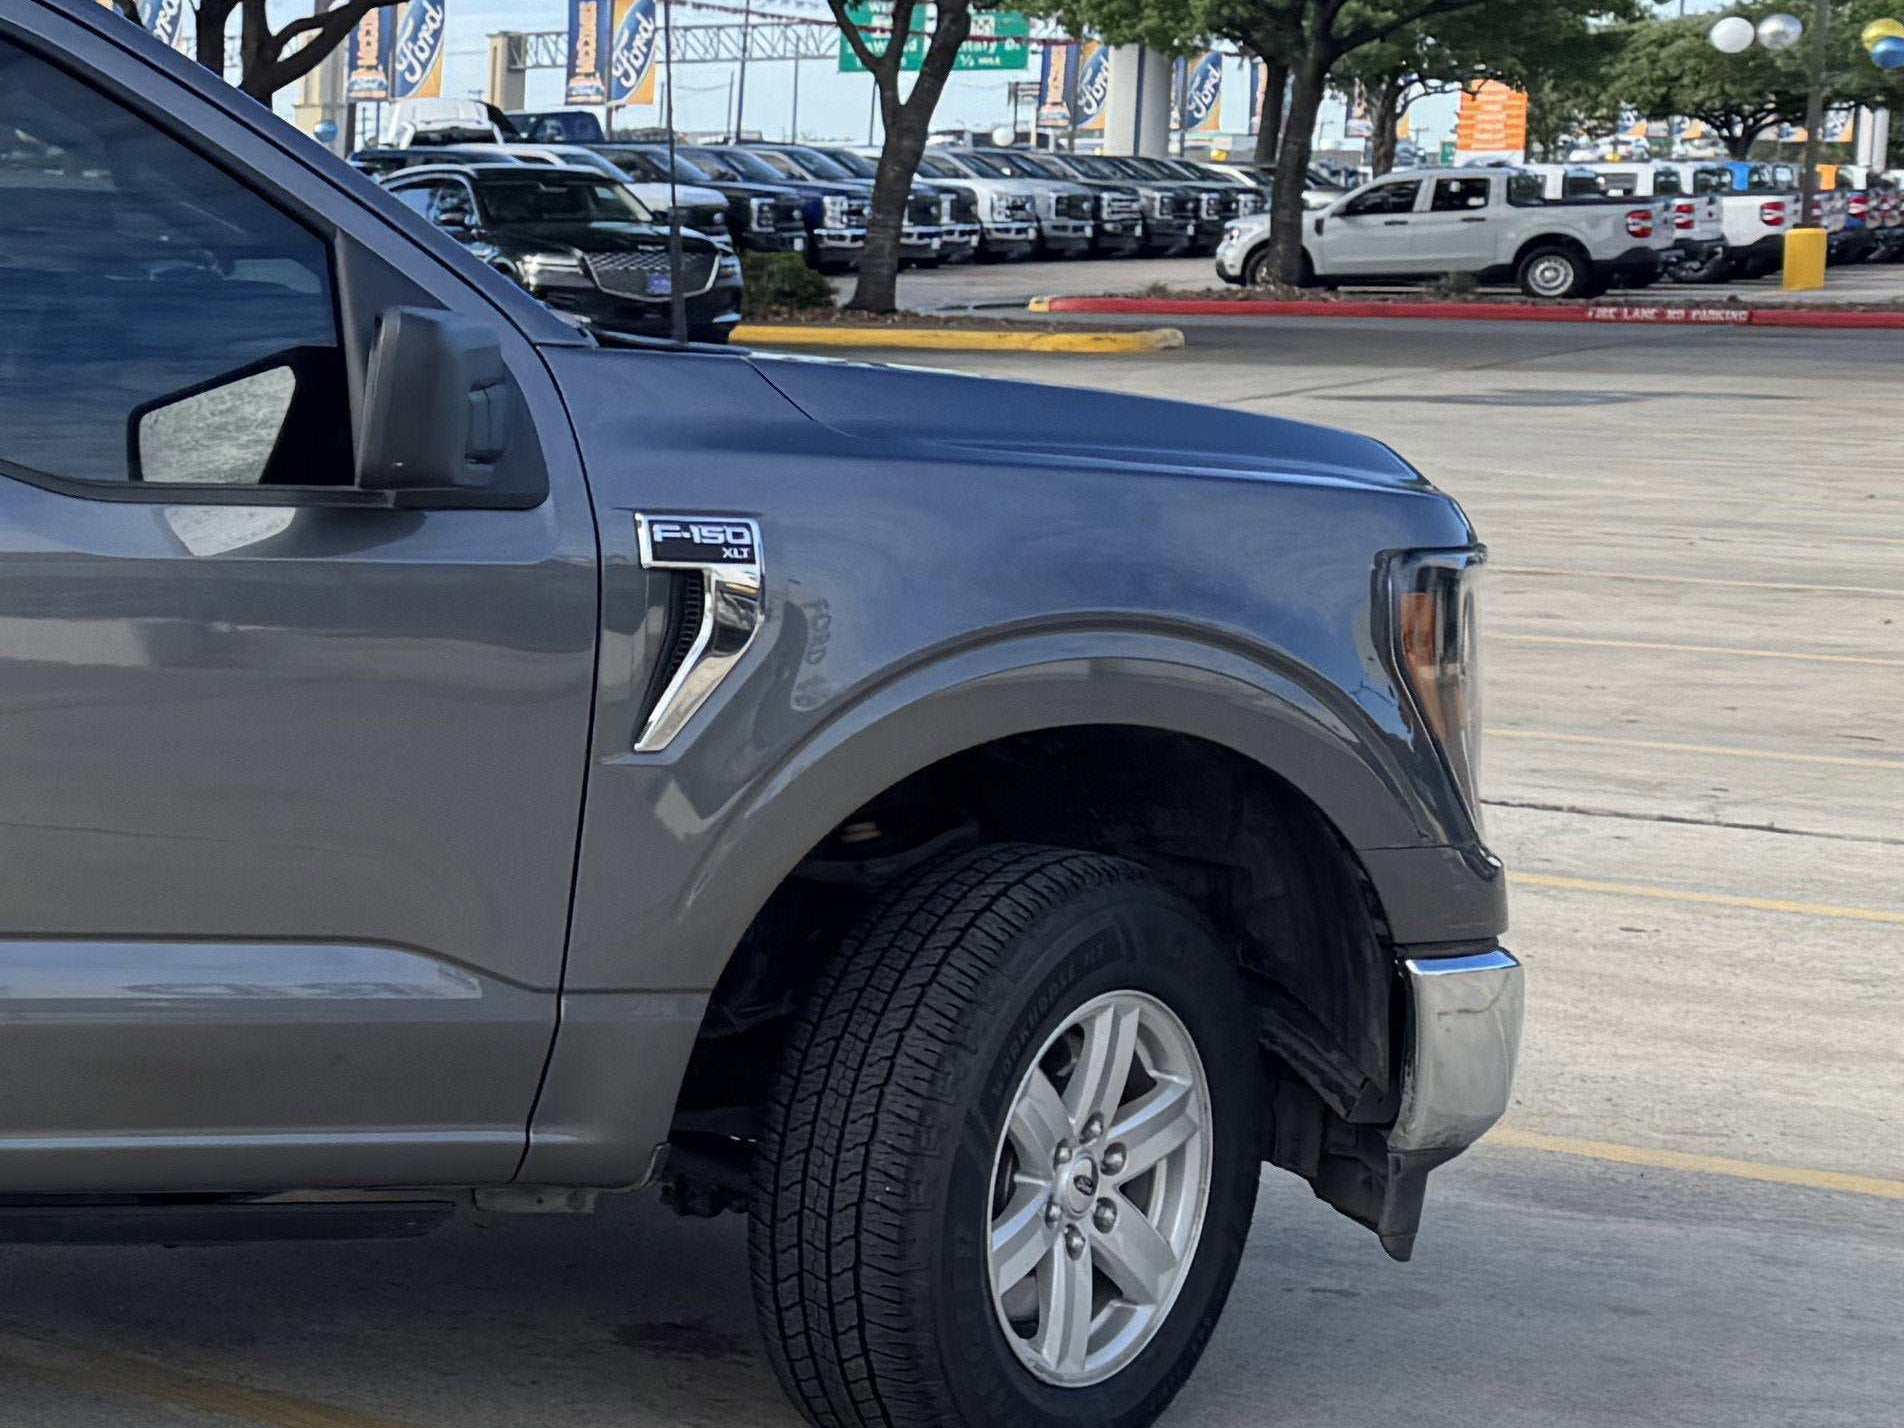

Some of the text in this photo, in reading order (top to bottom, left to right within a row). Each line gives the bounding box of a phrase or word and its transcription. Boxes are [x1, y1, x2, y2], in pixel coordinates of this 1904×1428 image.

[395, 0, 444, 84] Ford
[612, 12, 655, 88] Ford
[1187, 63, 1222, 119] Ford
[1622, 307, 1658, 321] LANE
[1691, 309, 1750, 322] PARKING
[652, 523, 752, 545] F-150
[722, 547, 750, 559] XLT
